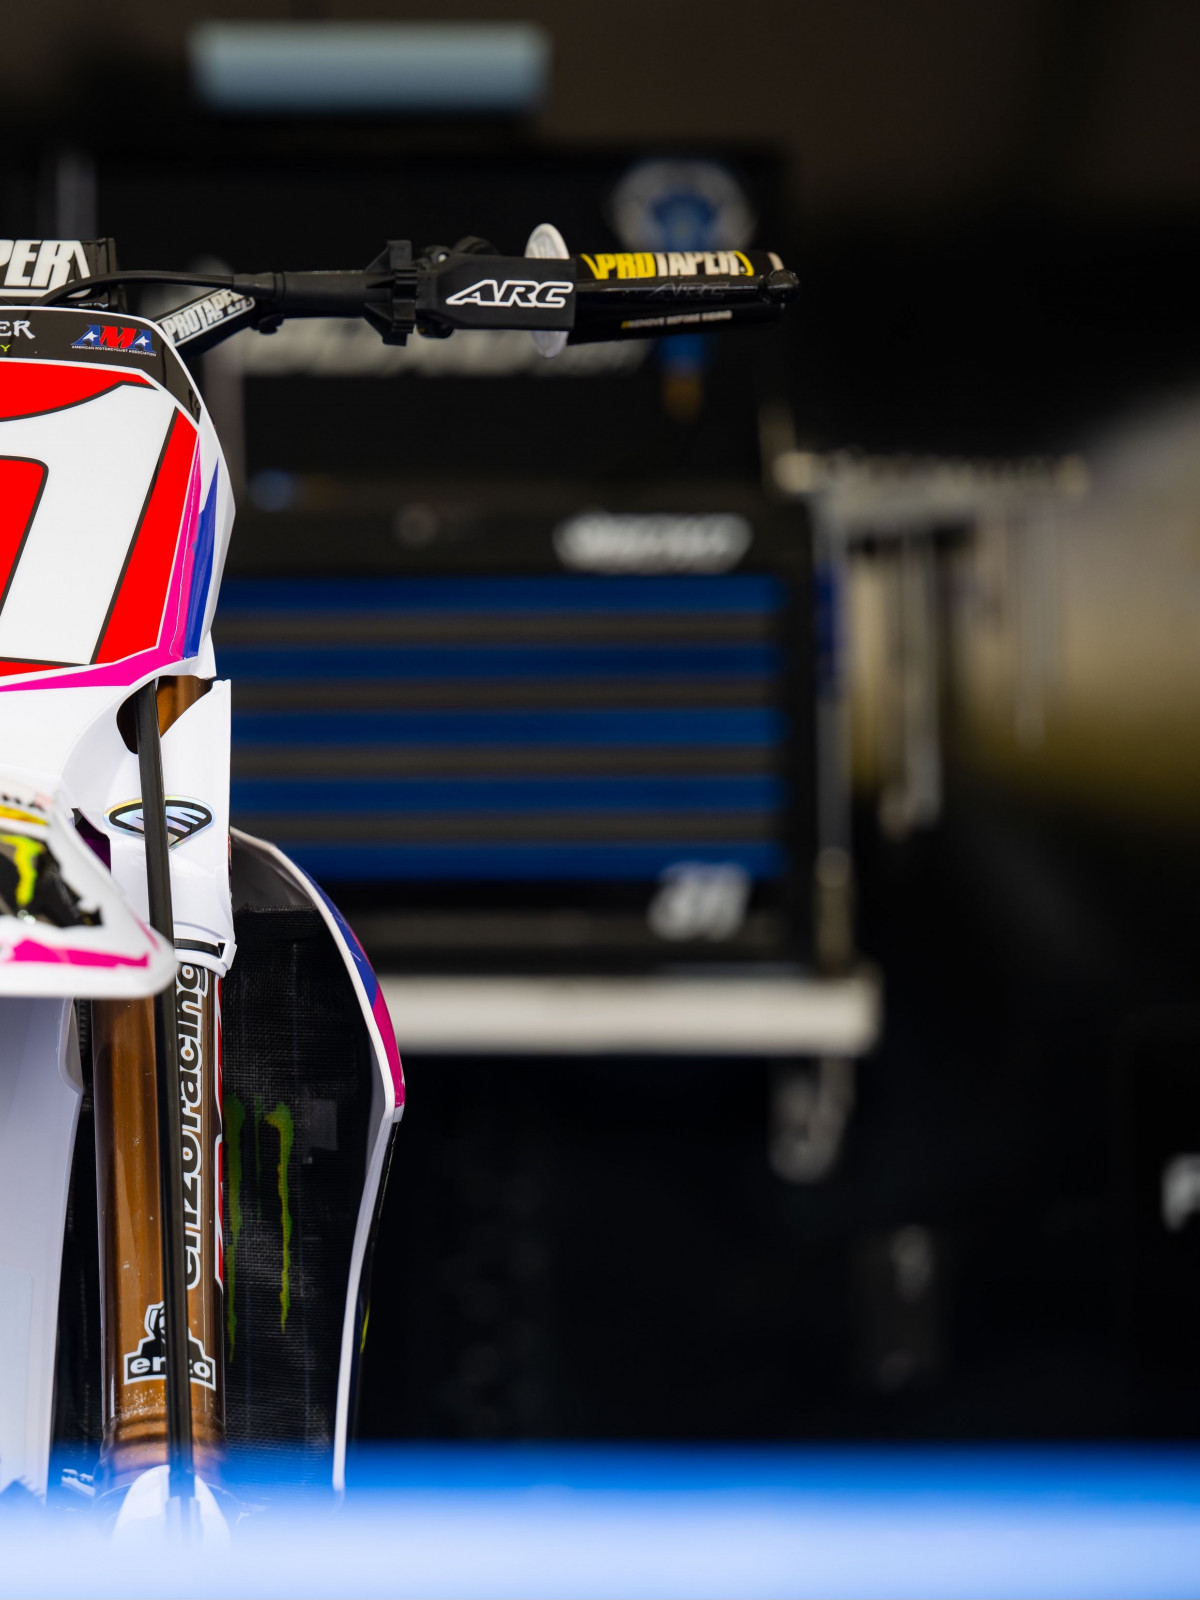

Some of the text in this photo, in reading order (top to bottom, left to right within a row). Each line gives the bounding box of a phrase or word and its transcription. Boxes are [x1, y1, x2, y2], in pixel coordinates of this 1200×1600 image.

[595, 251, 740, 279] PROTAPER
[446, 279, 574, 308] ARC
[71, 324, 157, 353] AMA
[130, 1356, 211, 1378] eno
